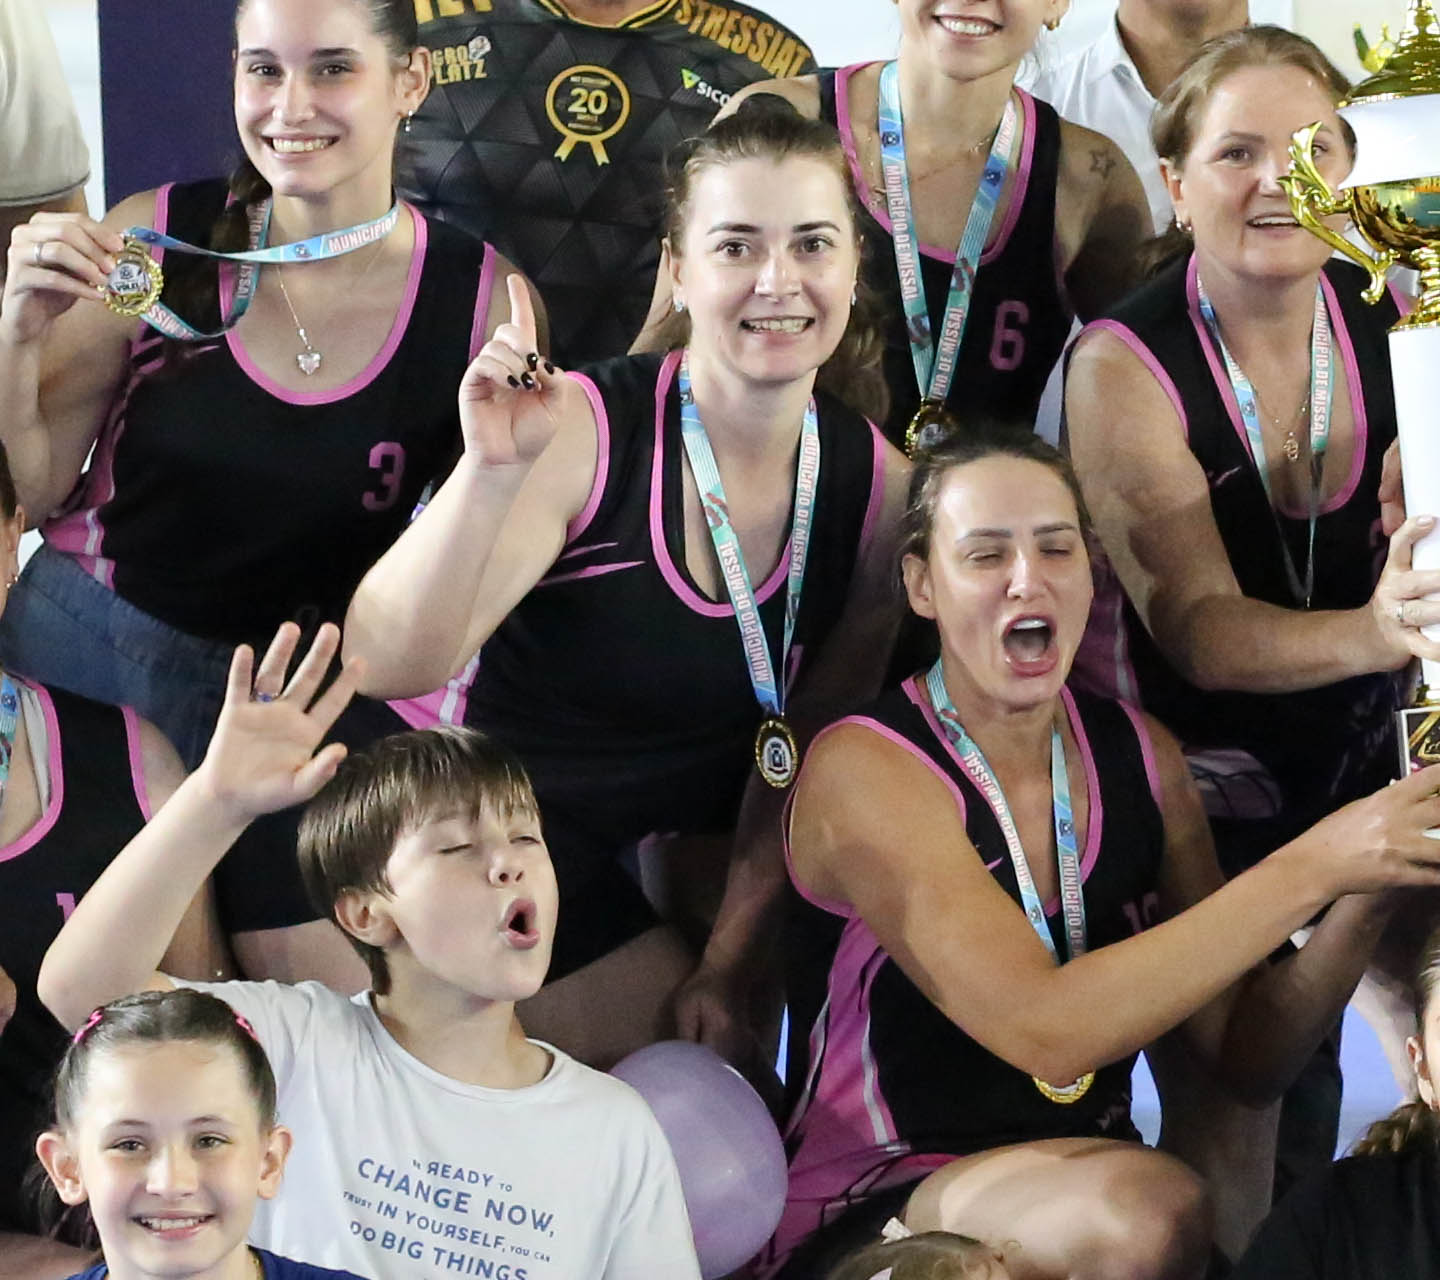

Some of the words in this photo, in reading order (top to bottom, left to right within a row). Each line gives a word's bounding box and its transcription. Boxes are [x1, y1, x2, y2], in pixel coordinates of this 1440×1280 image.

[568, 88, 609, 115] 20
[989, 300, 1030, 371] 6
[362, 442, 405, 511] 3
[358, 1158, 472, 1213] CHANGE
[485, 1198, 555, 1238] NOW,
[377, 1201, 398, 1219] IN
[350, 1220, 376, 1242] DO
[381, 1230, 425, 1260] BIG
